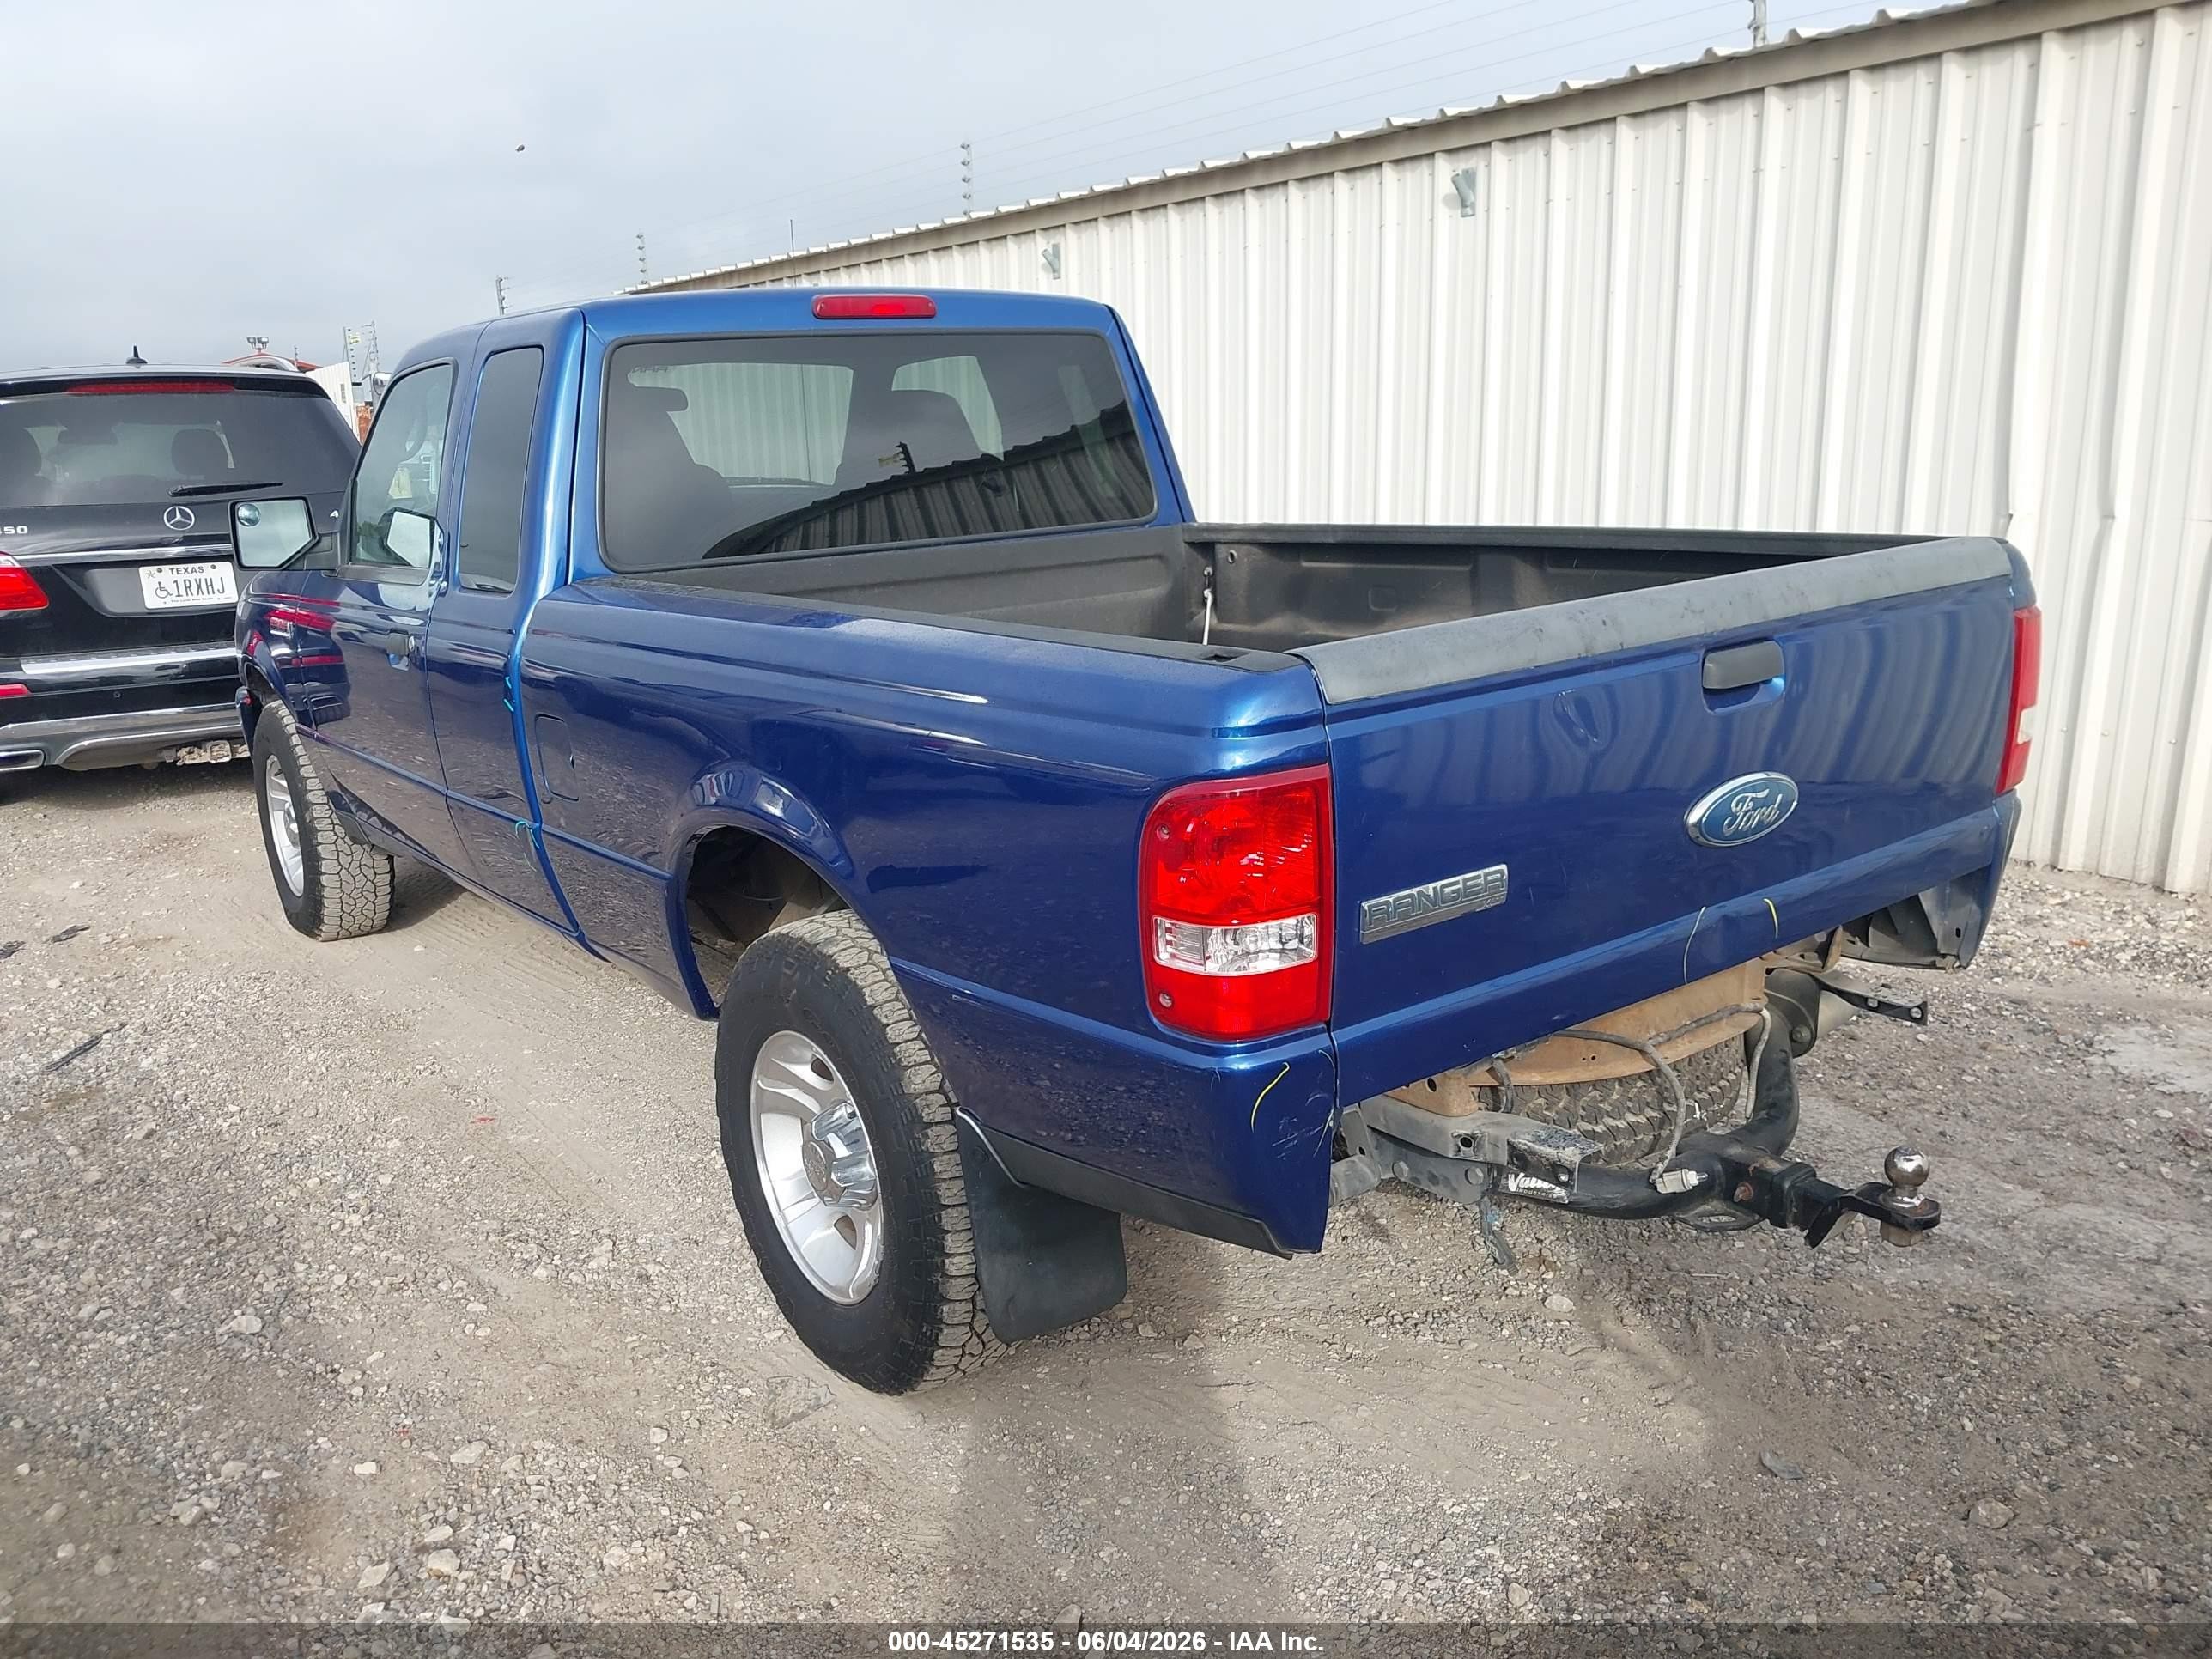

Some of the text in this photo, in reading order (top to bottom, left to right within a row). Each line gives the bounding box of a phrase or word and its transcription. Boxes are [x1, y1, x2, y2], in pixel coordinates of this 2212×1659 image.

[0, 526, 28, 534] 50
[169, 566, 204, 575] TEXAS
[173, 576, 225, 597] 1RXHJ
[1366, 868, 1508, 927] RANGER
